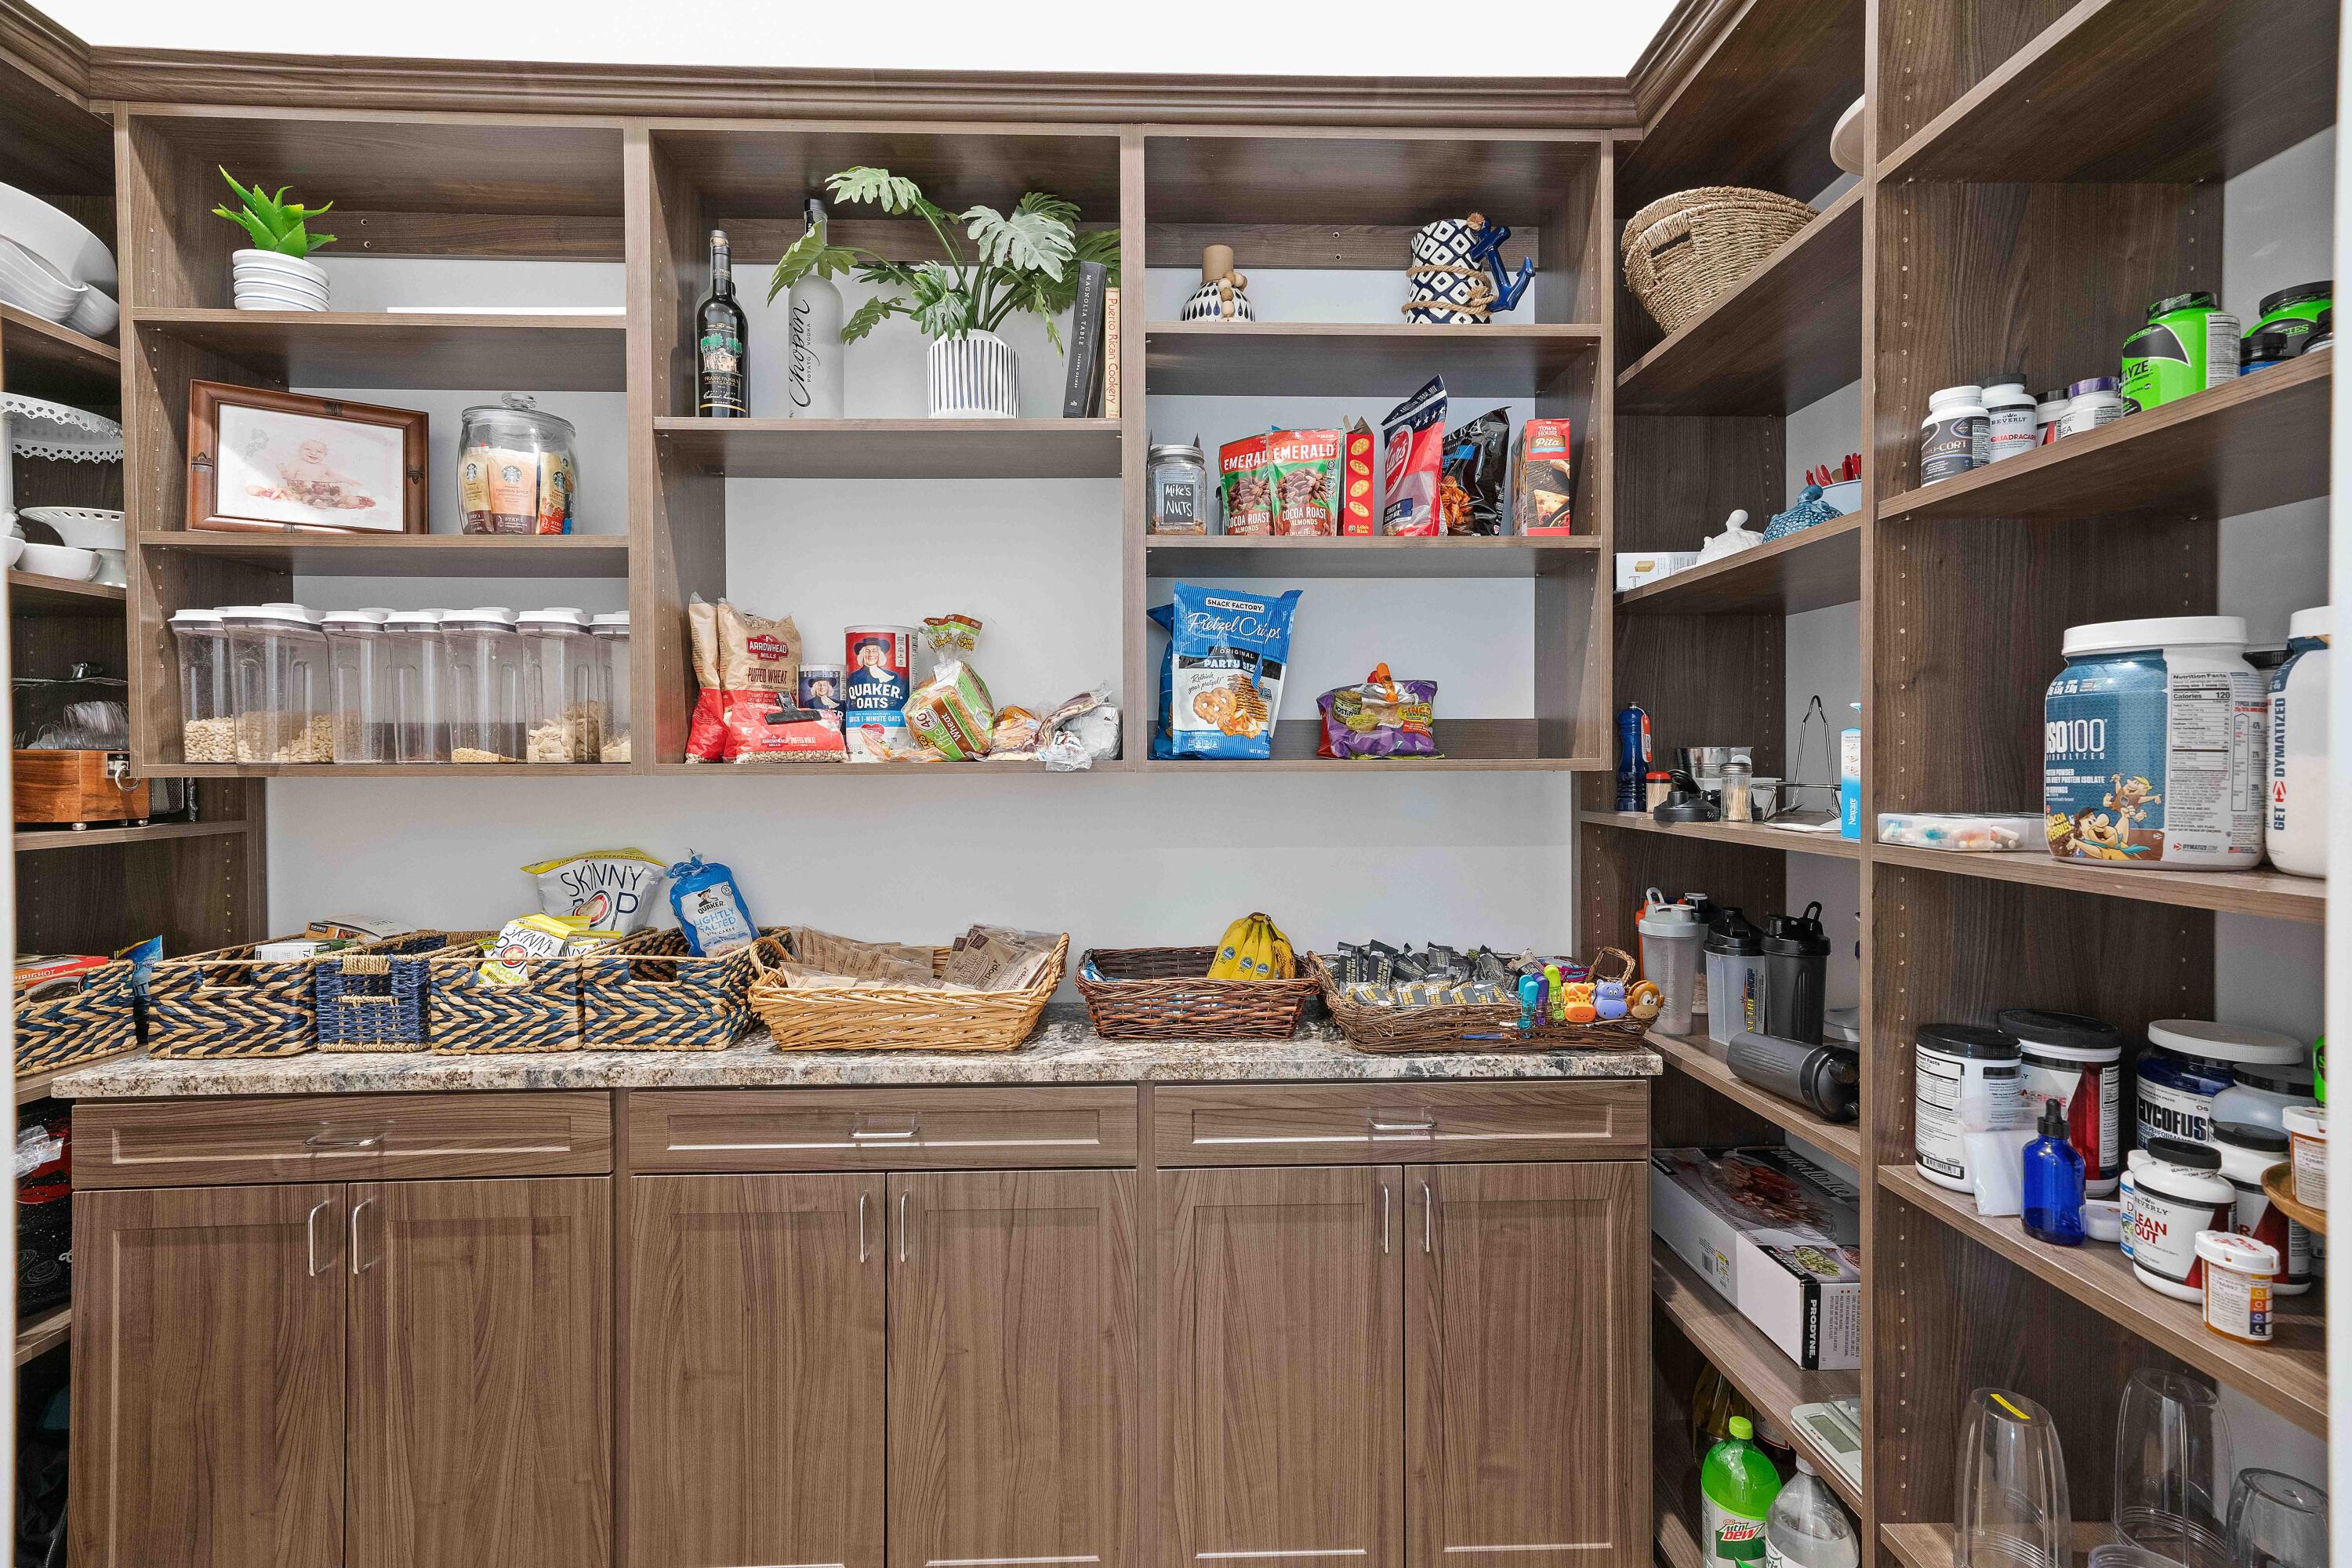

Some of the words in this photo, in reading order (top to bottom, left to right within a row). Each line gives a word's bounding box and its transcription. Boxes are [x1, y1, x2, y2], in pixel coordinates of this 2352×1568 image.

[1083, 274, 1092, 318] MAGNOLIA
[1108, 298, 1118, 331] Puerto
[1078, 321, 1087, 346] TABLE
[789, 299, 820, 408] Chopin
[1108, 334, 1118, 360] Rican
[1106, 363, 1118, 405] Cookery
[1273, 443, 1334, 460] EMERALD
[1535, 438, 1561, 447] Pita
[1224, 452, 1267, 471] EMERAL
[1165, 484, 1192, 496] Mike's
[1166, 501, 1192, 517] NUTS
[1283, 507, 1305, 522] COCOA
[1306, 506, 1327, 519] ROAST
[1229, 515, 1246, 528] COCOA
[1248, 512, 1270, 524] ROAST
[1235, 525, 1259, 534] ALMONDS
[1207, 599, 1230, 608] SNACK
[1186, 612, 1240, 639] Pretzel
[1239, 616, 1281, 644] Crisps
[749, 641, 787, 654] ARROWHEAD
[1219, 648, 1254, 659] ORIGINAL
[1203, 658, 1240, 669] PARTY
[1243, 662, 1256, 671] SIZ
[747, 666, 767, 683] PUFFED
[768, 670, 788, 684] WHEAT
[1191, 671, 1214, 684] Rethink
[1188, 684, 1200, 695] your
[856, 697, 888, 709] OATS
[942, 713, 962, 741] Wheat
[2274, 698, 2286, 778] DYMATIZED
[1849, 797, 1857, 826] Nexcare
[2274, 806, 2286, 831] GET
[560, 863, 647, 897] SKINNY
[693, 907, 735, 926] LIGHTLY
[698, 900, 724, 914] QUAKER
[699, 916, 736, 933] SALTED
[506, 926, 554, 955] SKINNY
[984, 960, 1001, 980] pop!
[2138, 1097, 2209, 1142] GLYCOFUS
[1769, 1149, 1813, 1177] Buffet
[1806, 1170, 1831, 1185] On
[1829, 1181, 1851, 1196] Ice
[2135, 1210, 2167, 1236] LEAN
[2134, 1223, 2158, 1244] OUT
[1726, 1523, 1746, 1532] Mtn
